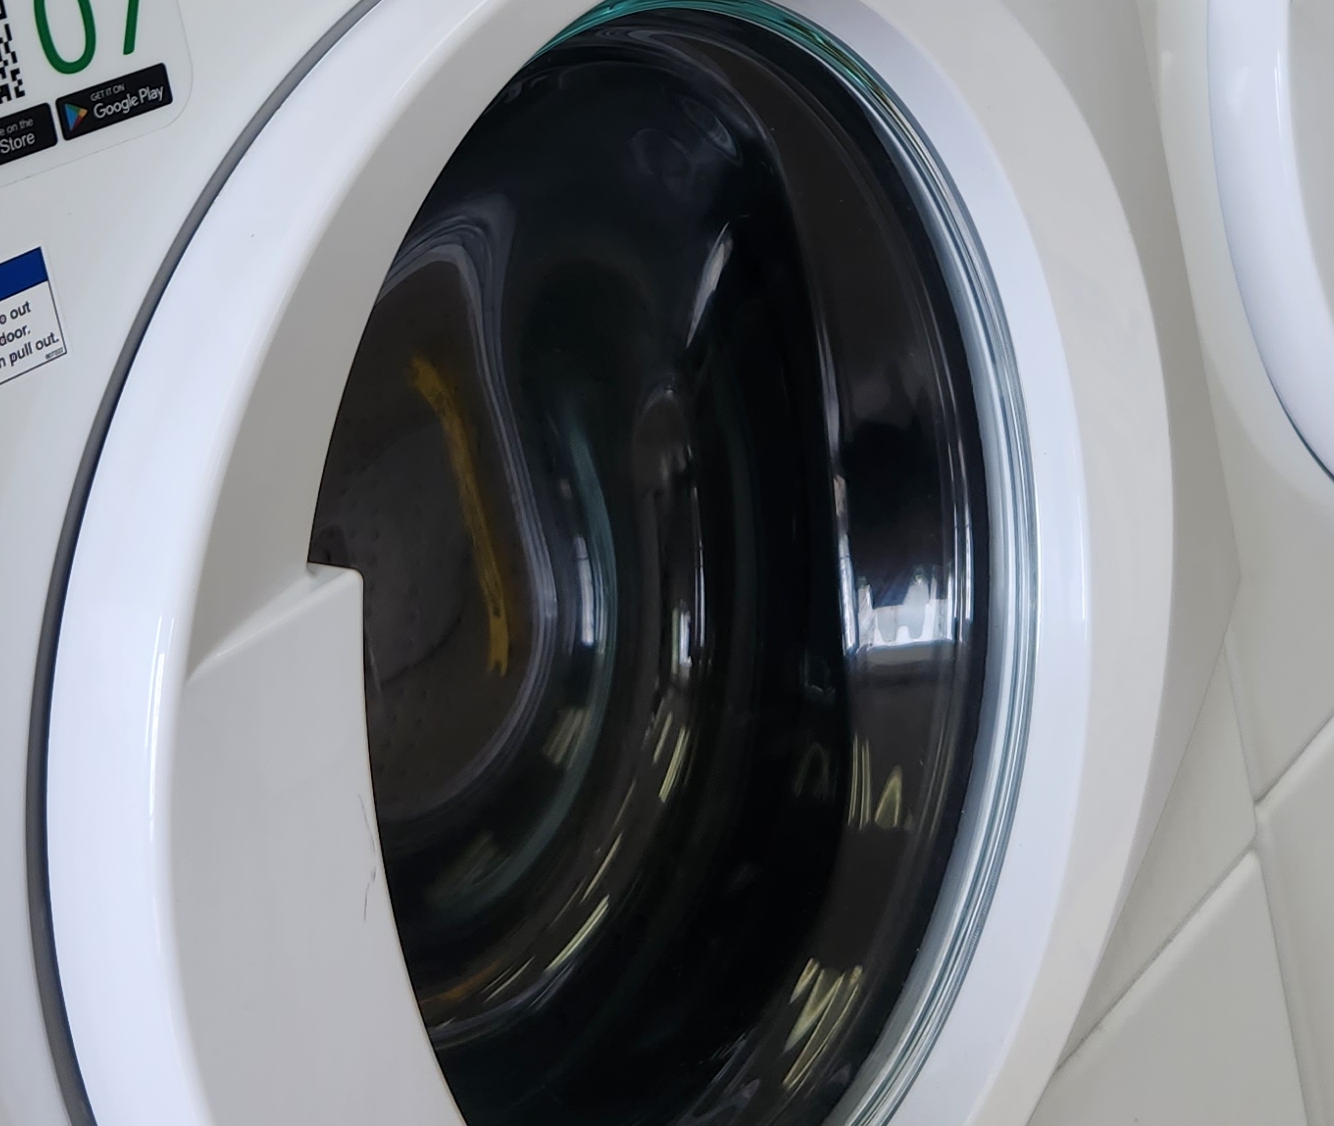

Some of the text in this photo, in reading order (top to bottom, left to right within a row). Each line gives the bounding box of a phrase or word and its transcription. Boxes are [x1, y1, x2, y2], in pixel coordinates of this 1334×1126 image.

[90, 90, 106, 102] GET
[112, 83, 126, 96] ON
[93, 85, 165, 120] Google Play
[6, 121, 19, 134] on
[18, 116, 34, 130] the
[0, 131, 36, 155] Store
[9, 300, 33, 321] out
[8, 342, 34, 368] pull
[34, 331, 61, 351] out.
